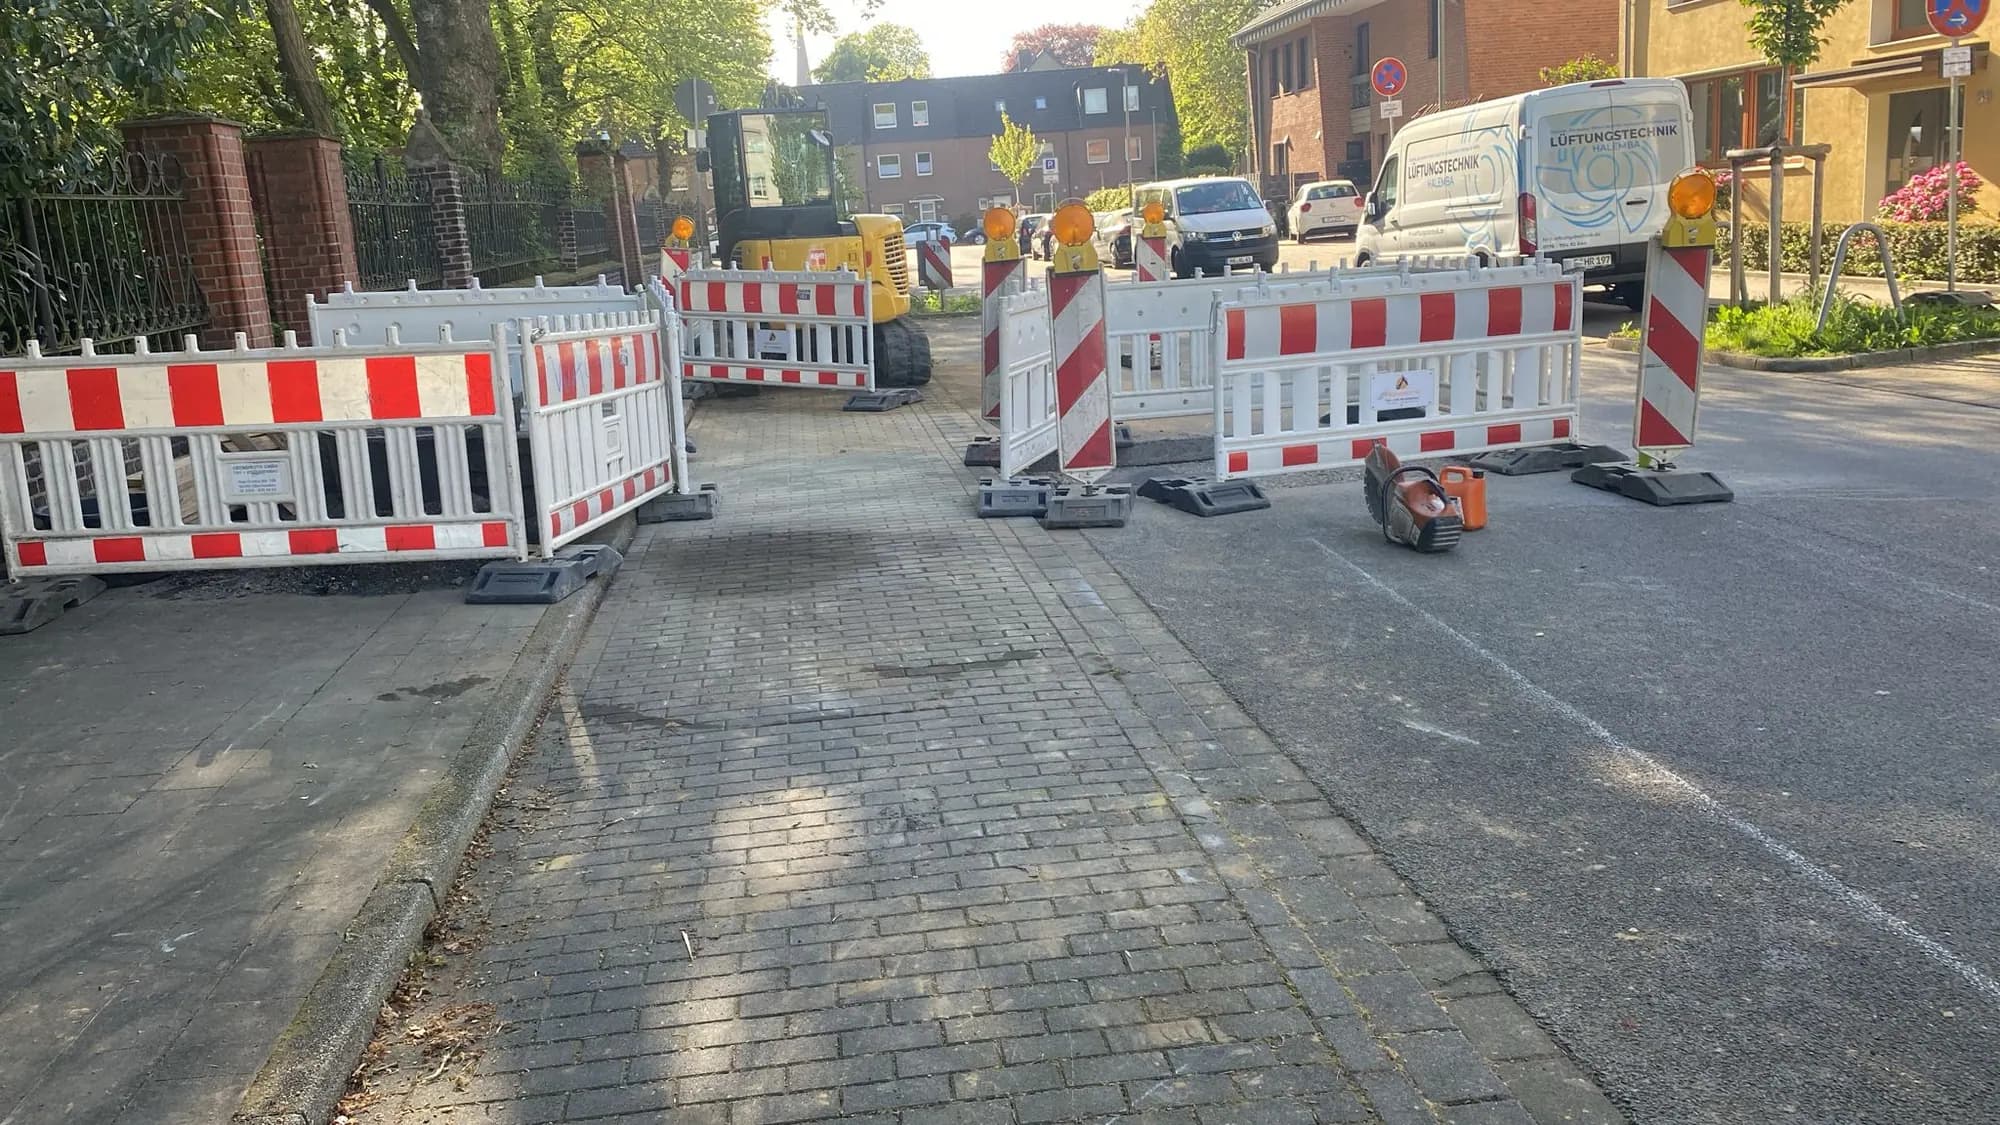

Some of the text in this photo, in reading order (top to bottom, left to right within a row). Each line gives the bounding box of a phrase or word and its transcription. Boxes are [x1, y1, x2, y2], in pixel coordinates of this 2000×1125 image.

[1550, 125, 1678, 148] LÜFTUNGSTECHNIK
[1592, 140, 1641, 153] HALEMBA
[1408, 153, 1480, 180] LÜFTUNGSTECHNIK
[1595, 255, 1610, 265] 197
